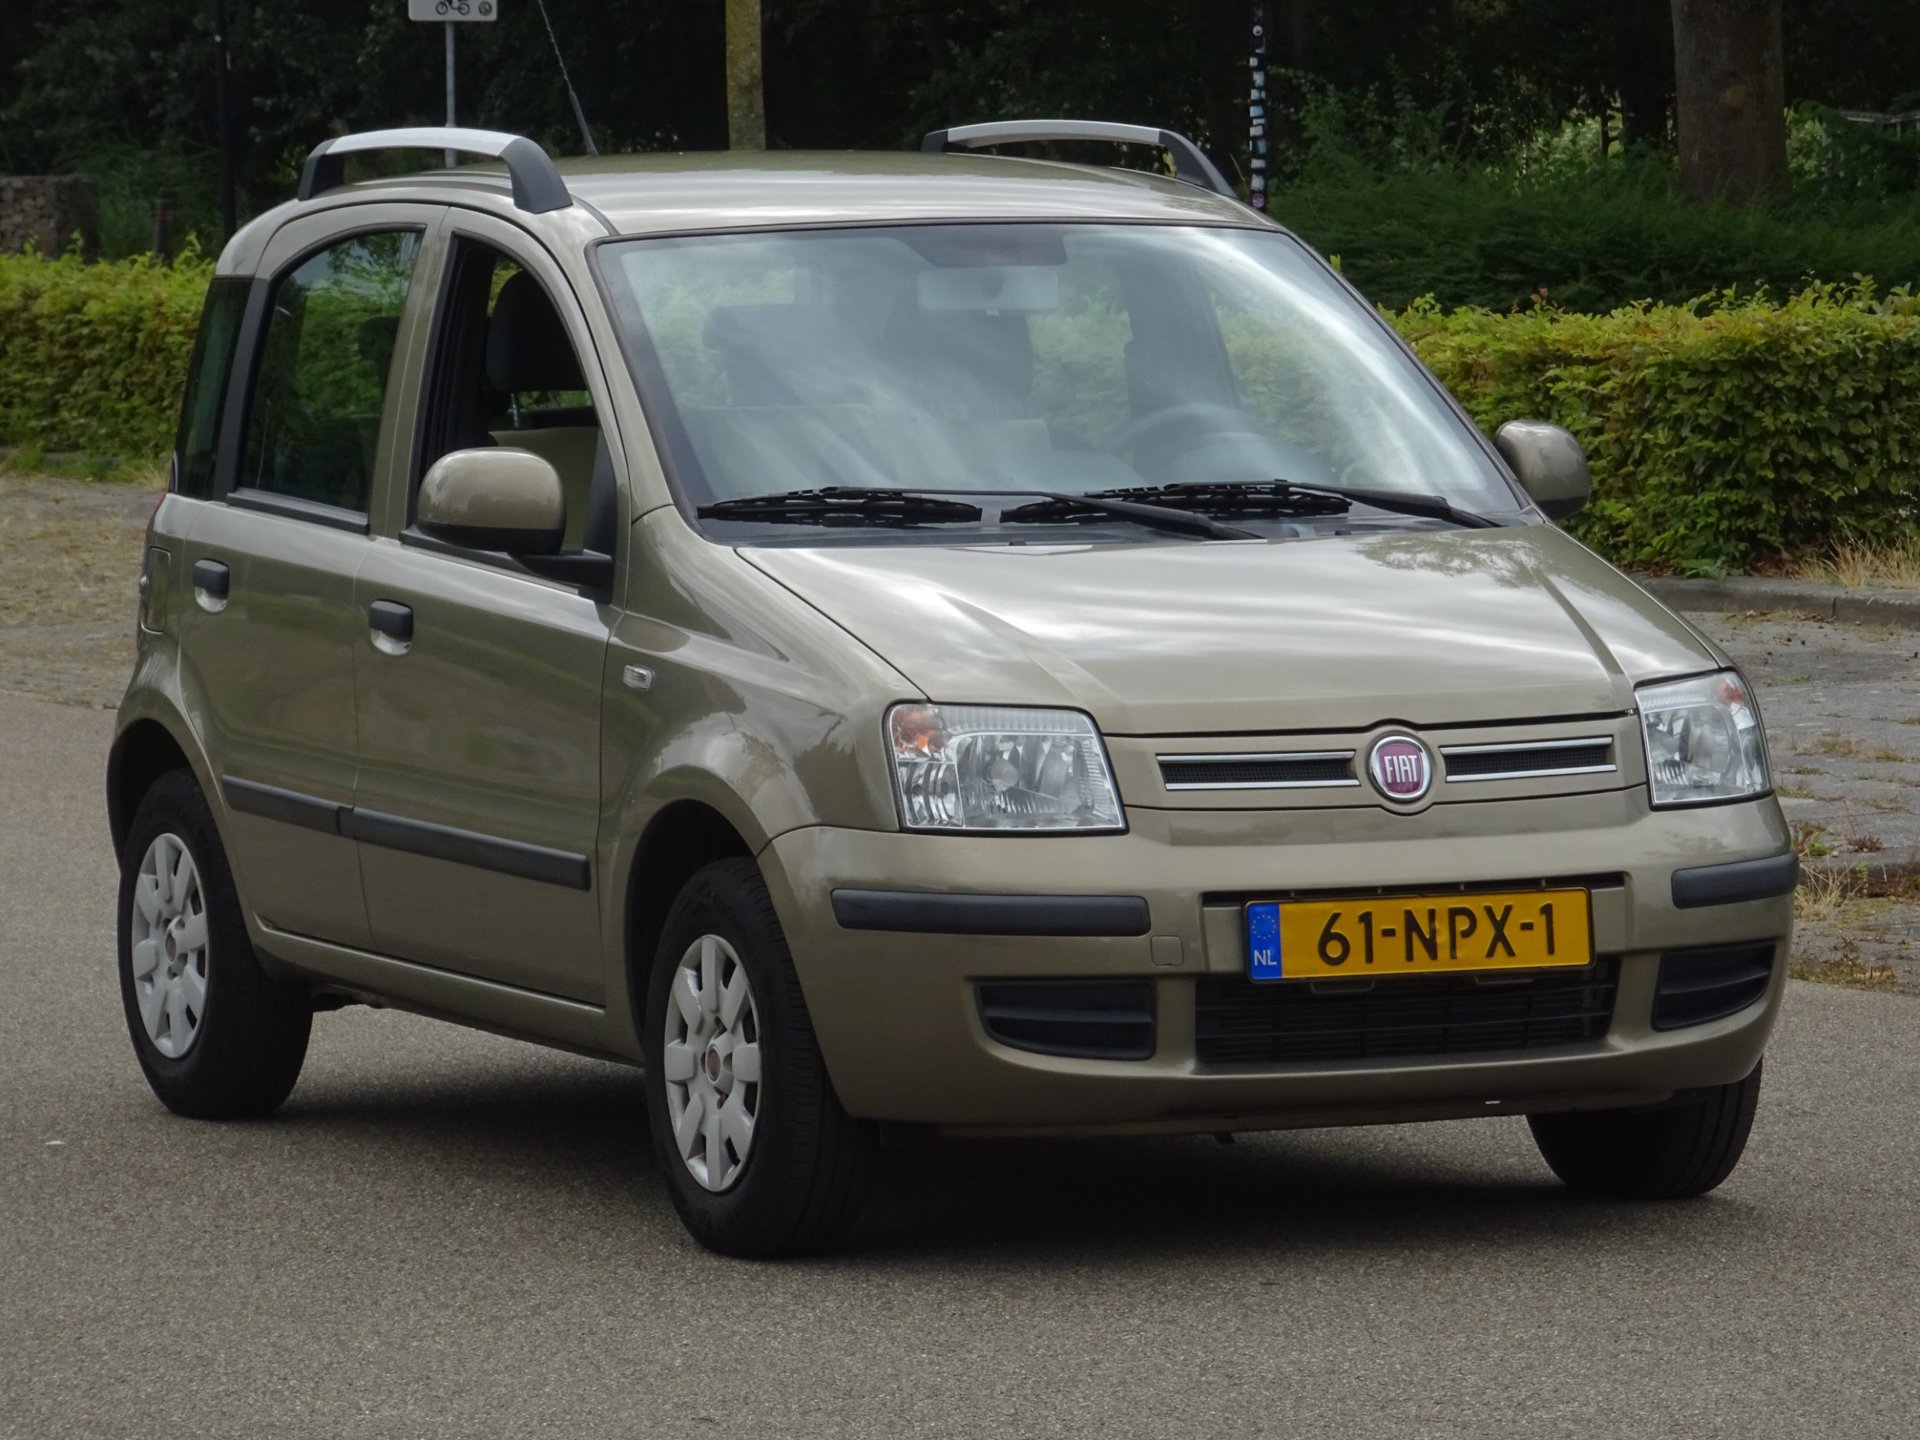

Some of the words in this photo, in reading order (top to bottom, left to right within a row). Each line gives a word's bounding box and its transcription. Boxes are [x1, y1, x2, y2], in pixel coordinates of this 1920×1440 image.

[1384, 755, 1417, 783] FIAT
[1317, 903, 1555, 966] 61-NPX-1
[1253, 949, 1277, 966] NL
